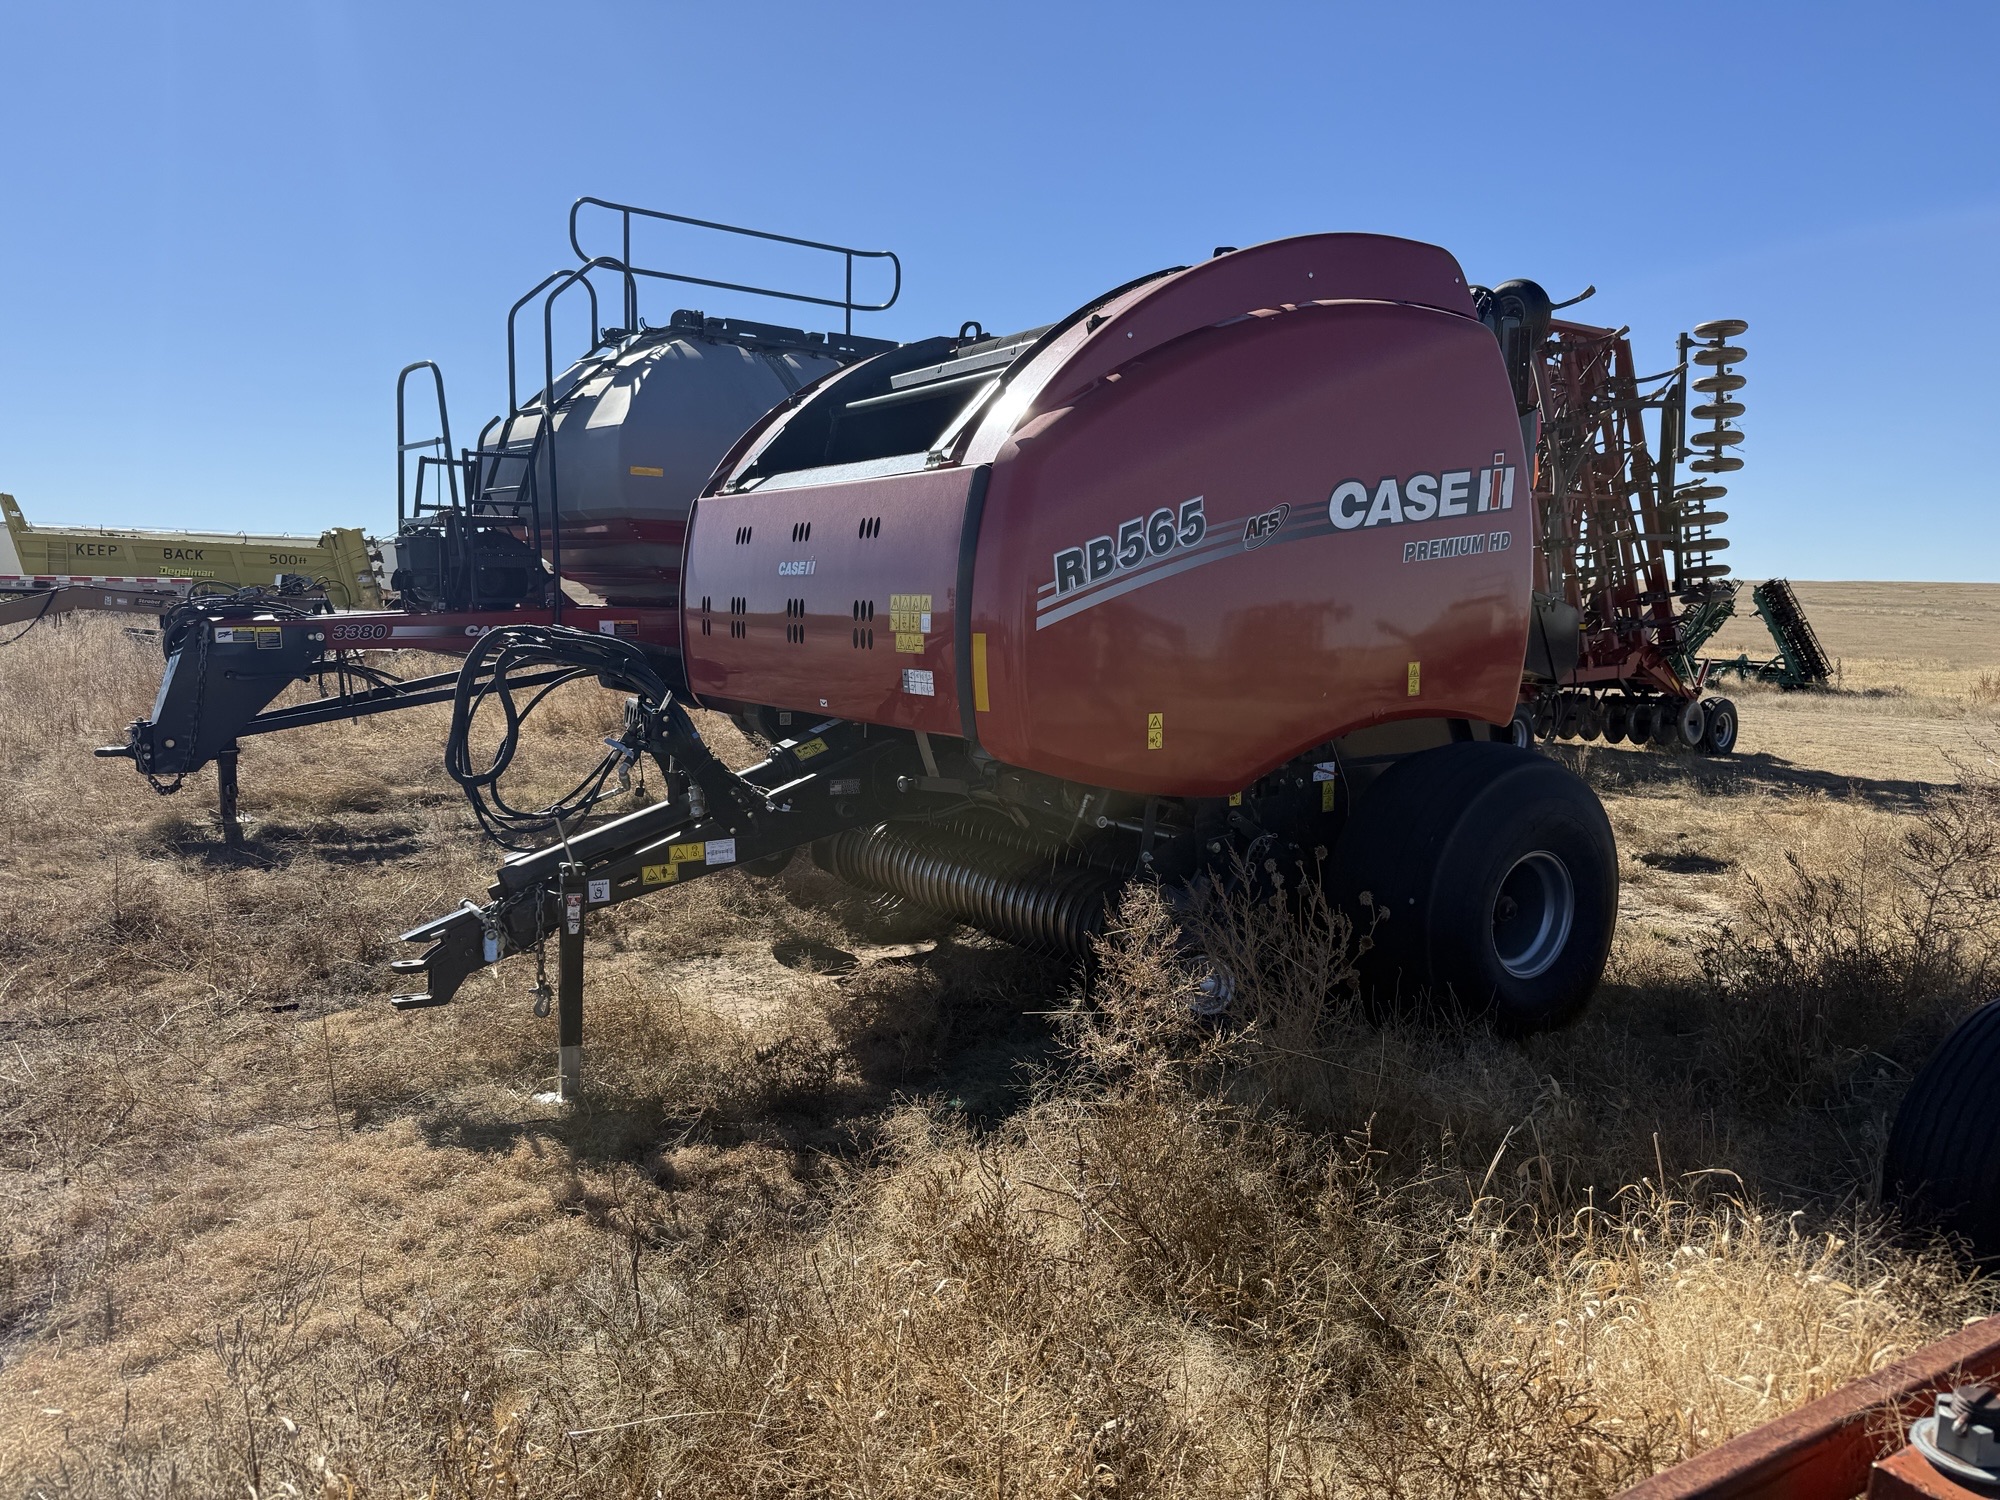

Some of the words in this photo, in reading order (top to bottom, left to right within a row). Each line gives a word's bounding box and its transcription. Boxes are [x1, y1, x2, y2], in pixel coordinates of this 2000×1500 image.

[1328, 472, 1471, 530] CASE
[1242, 510, 1281, 541] AFS
[75, 543, 118, 556] KEEP
[163, 548, 204, 560] BACK
[1054, 495, 1207, 597] RB565
[1402, 533, 1485, 563] PREMIUM
[1488, 531, 1511, 552] HD
[159, 566, 215, 577] Degelman
[778, 561, 806, 576] CASE
[332, 624, 387, 640] 3380
[464, 625, 500, 637] CA
